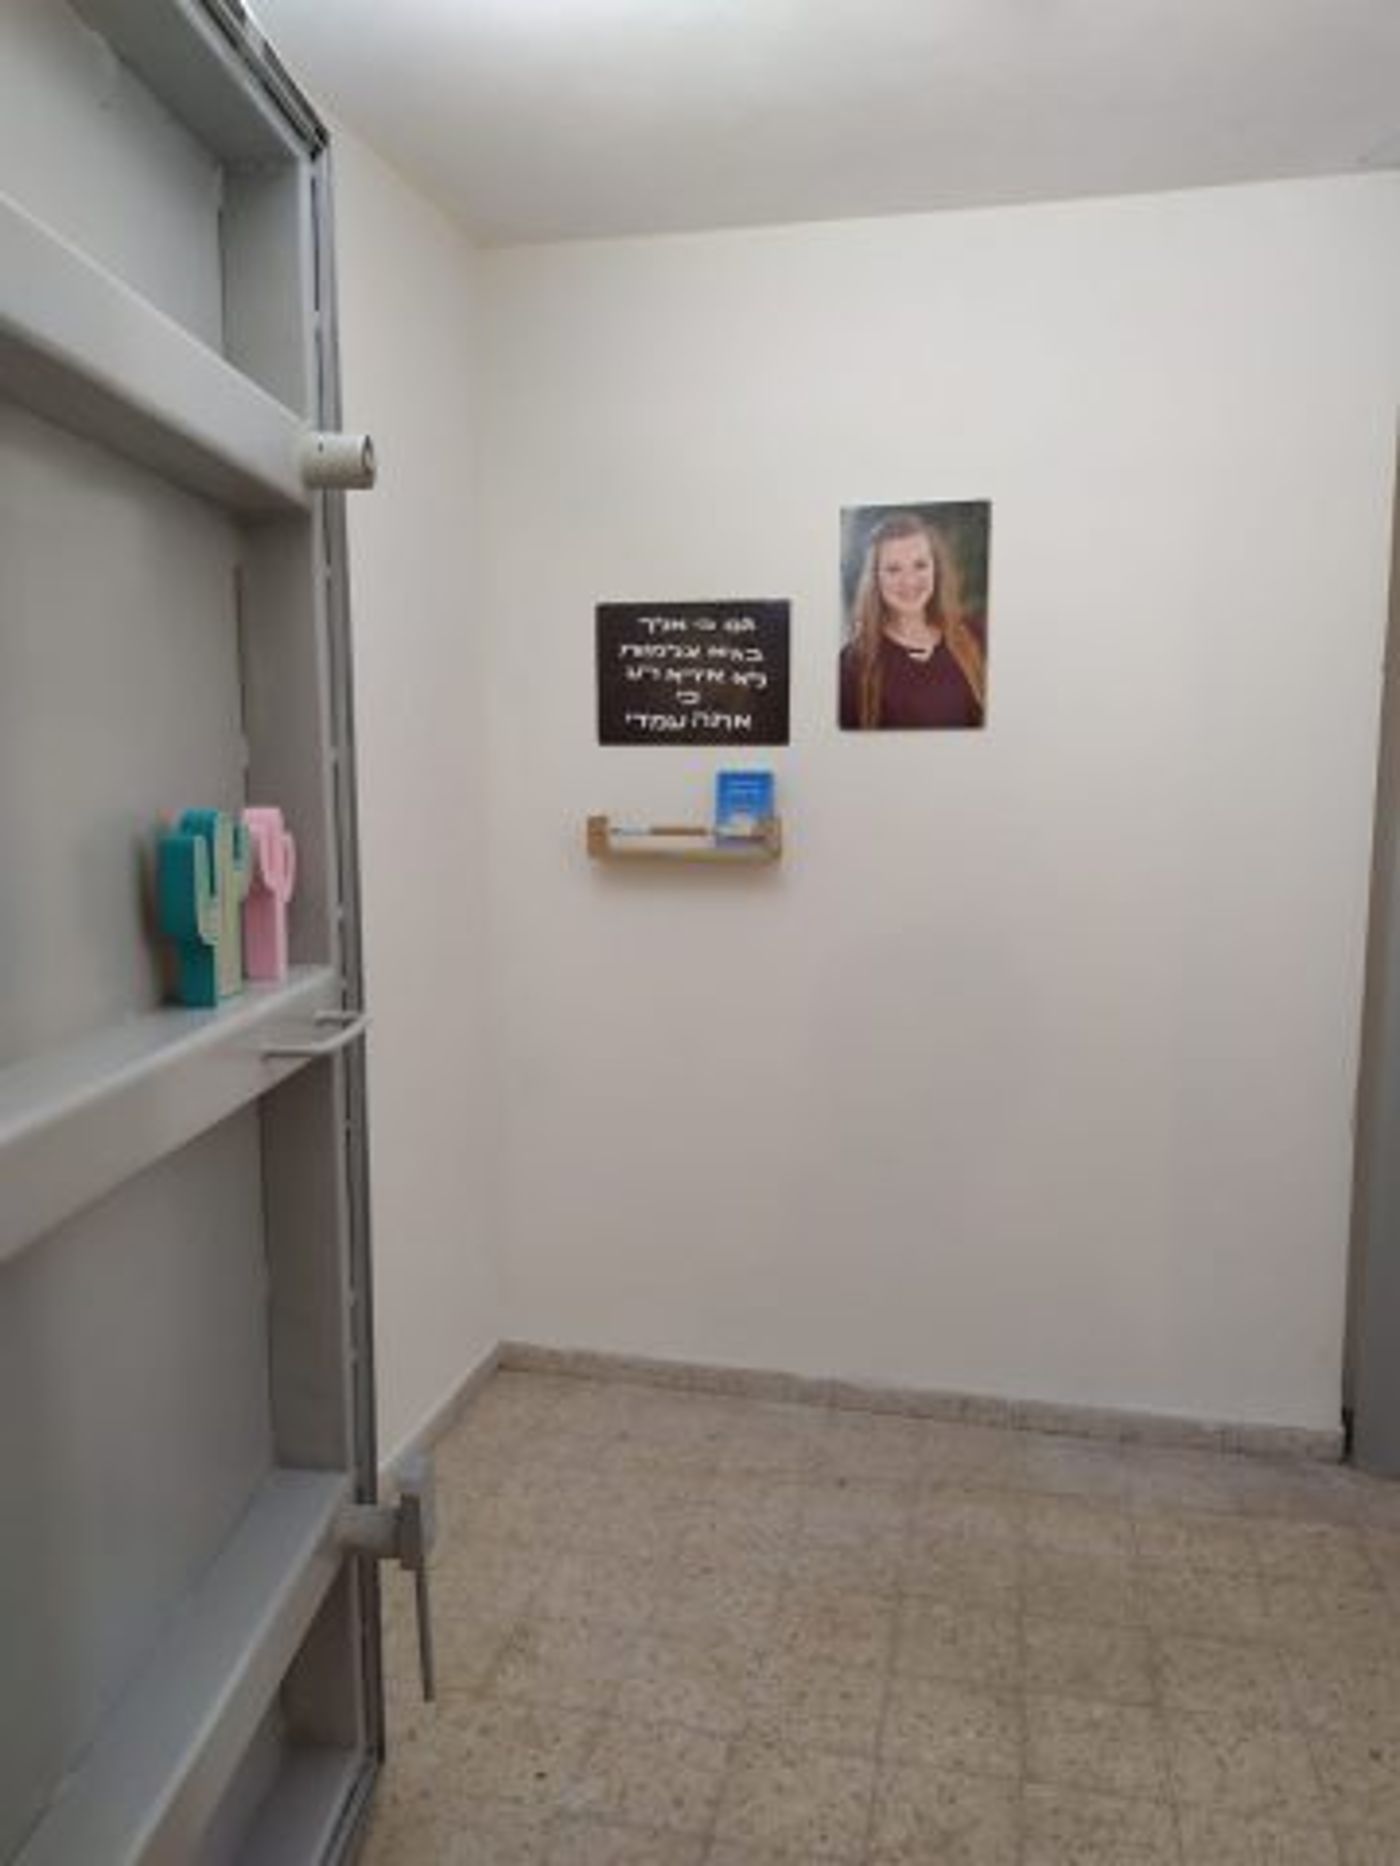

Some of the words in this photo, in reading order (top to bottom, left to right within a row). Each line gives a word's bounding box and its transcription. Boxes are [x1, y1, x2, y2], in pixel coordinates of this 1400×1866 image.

[675, 689, 701, 705] כי
[624, 713, 687, 732] עמדי
[691, 710, 752, 731] אתה
